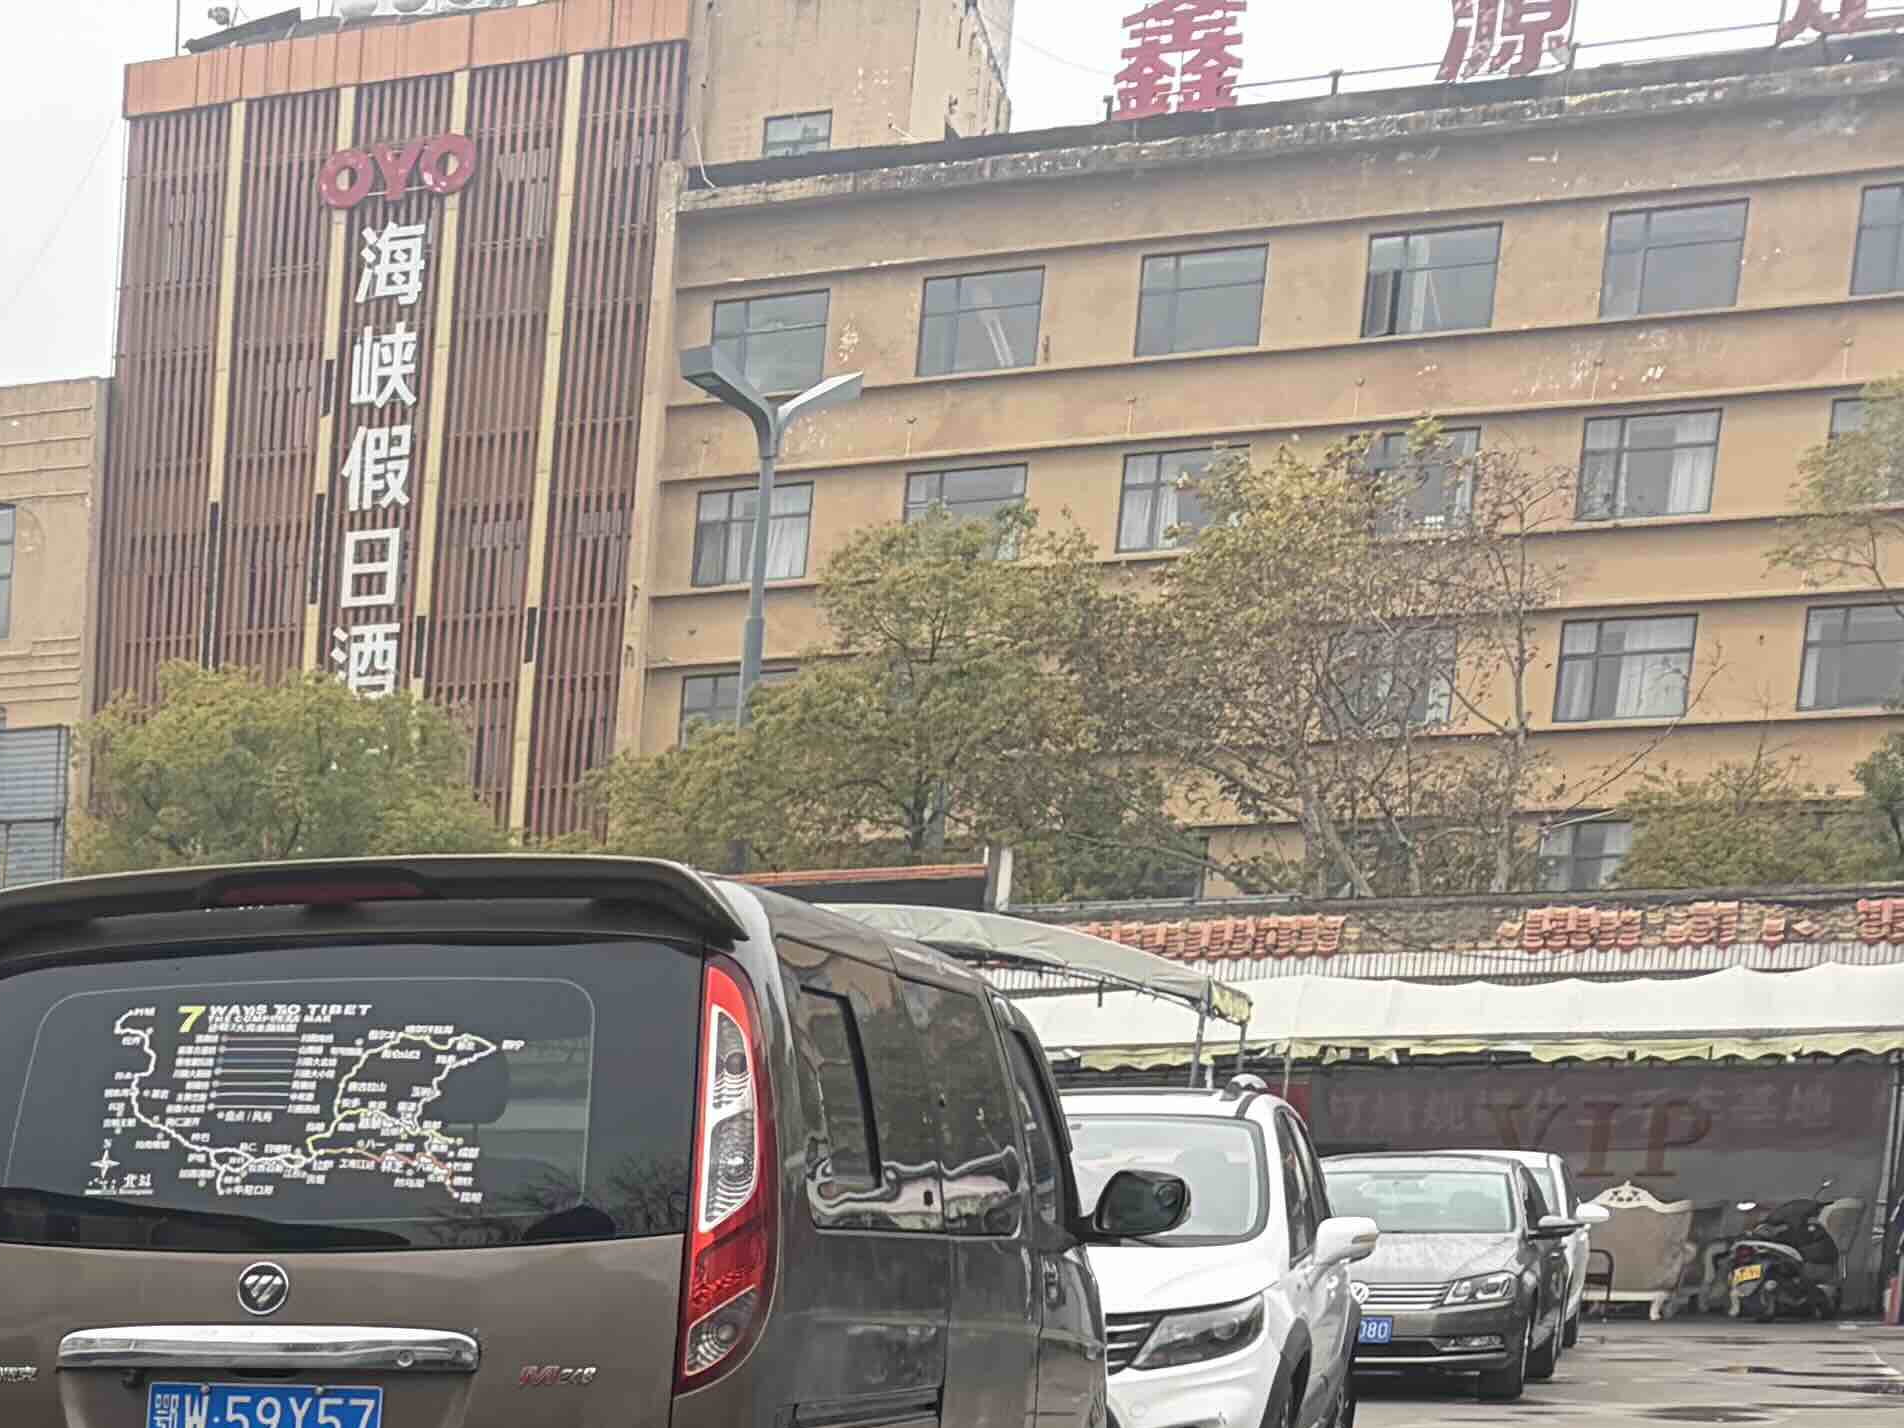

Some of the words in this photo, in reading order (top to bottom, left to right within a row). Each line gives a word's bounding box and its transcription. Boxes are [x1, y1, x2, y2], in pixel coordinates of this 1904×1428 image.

[318, 132, 476, 209] OYO
[330, 220, 426, 698] 海峡假日酒
[178, 1005, 207, 1033] 7
[208, 1004, 268, 1016] WAYS
[1487, 1102, 1712, 1178] VIP
